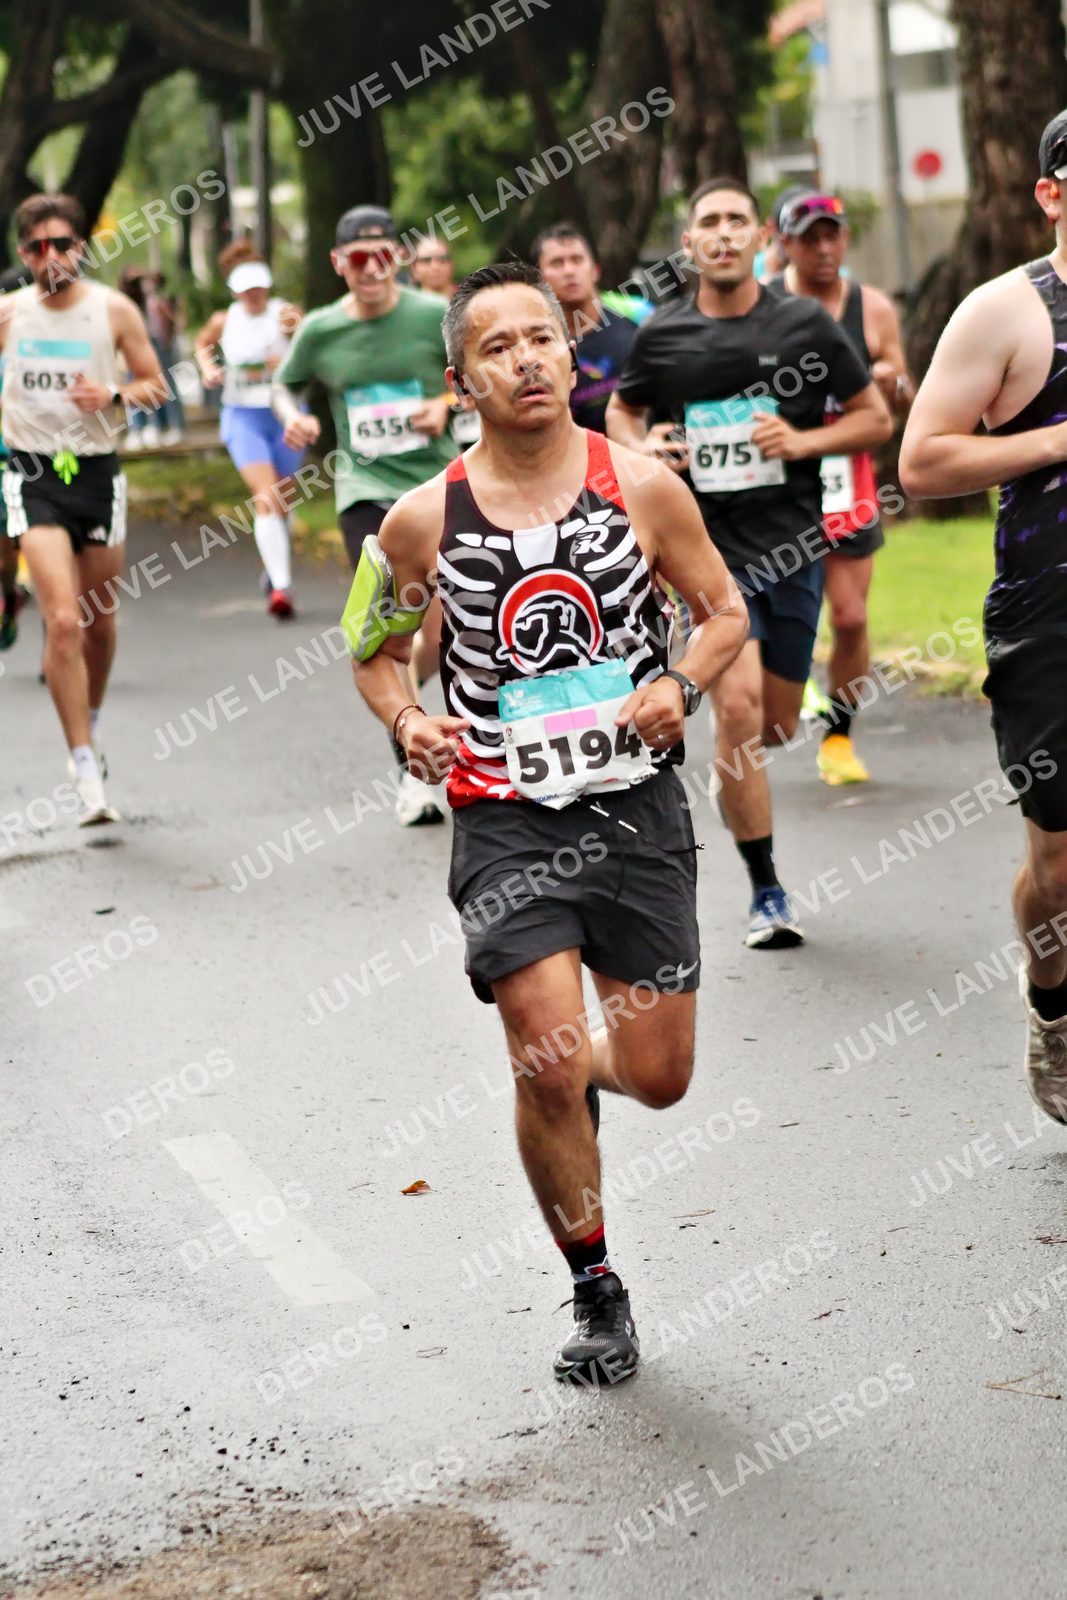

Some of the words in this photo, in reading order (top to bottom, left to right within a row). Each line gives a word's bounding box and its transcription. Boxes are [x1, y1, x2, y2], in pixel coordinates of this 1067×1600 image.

[23, 369, 83, 391] 603
[696, 441, 768, 468] 675
[516, 726, 642, 784] 5194
